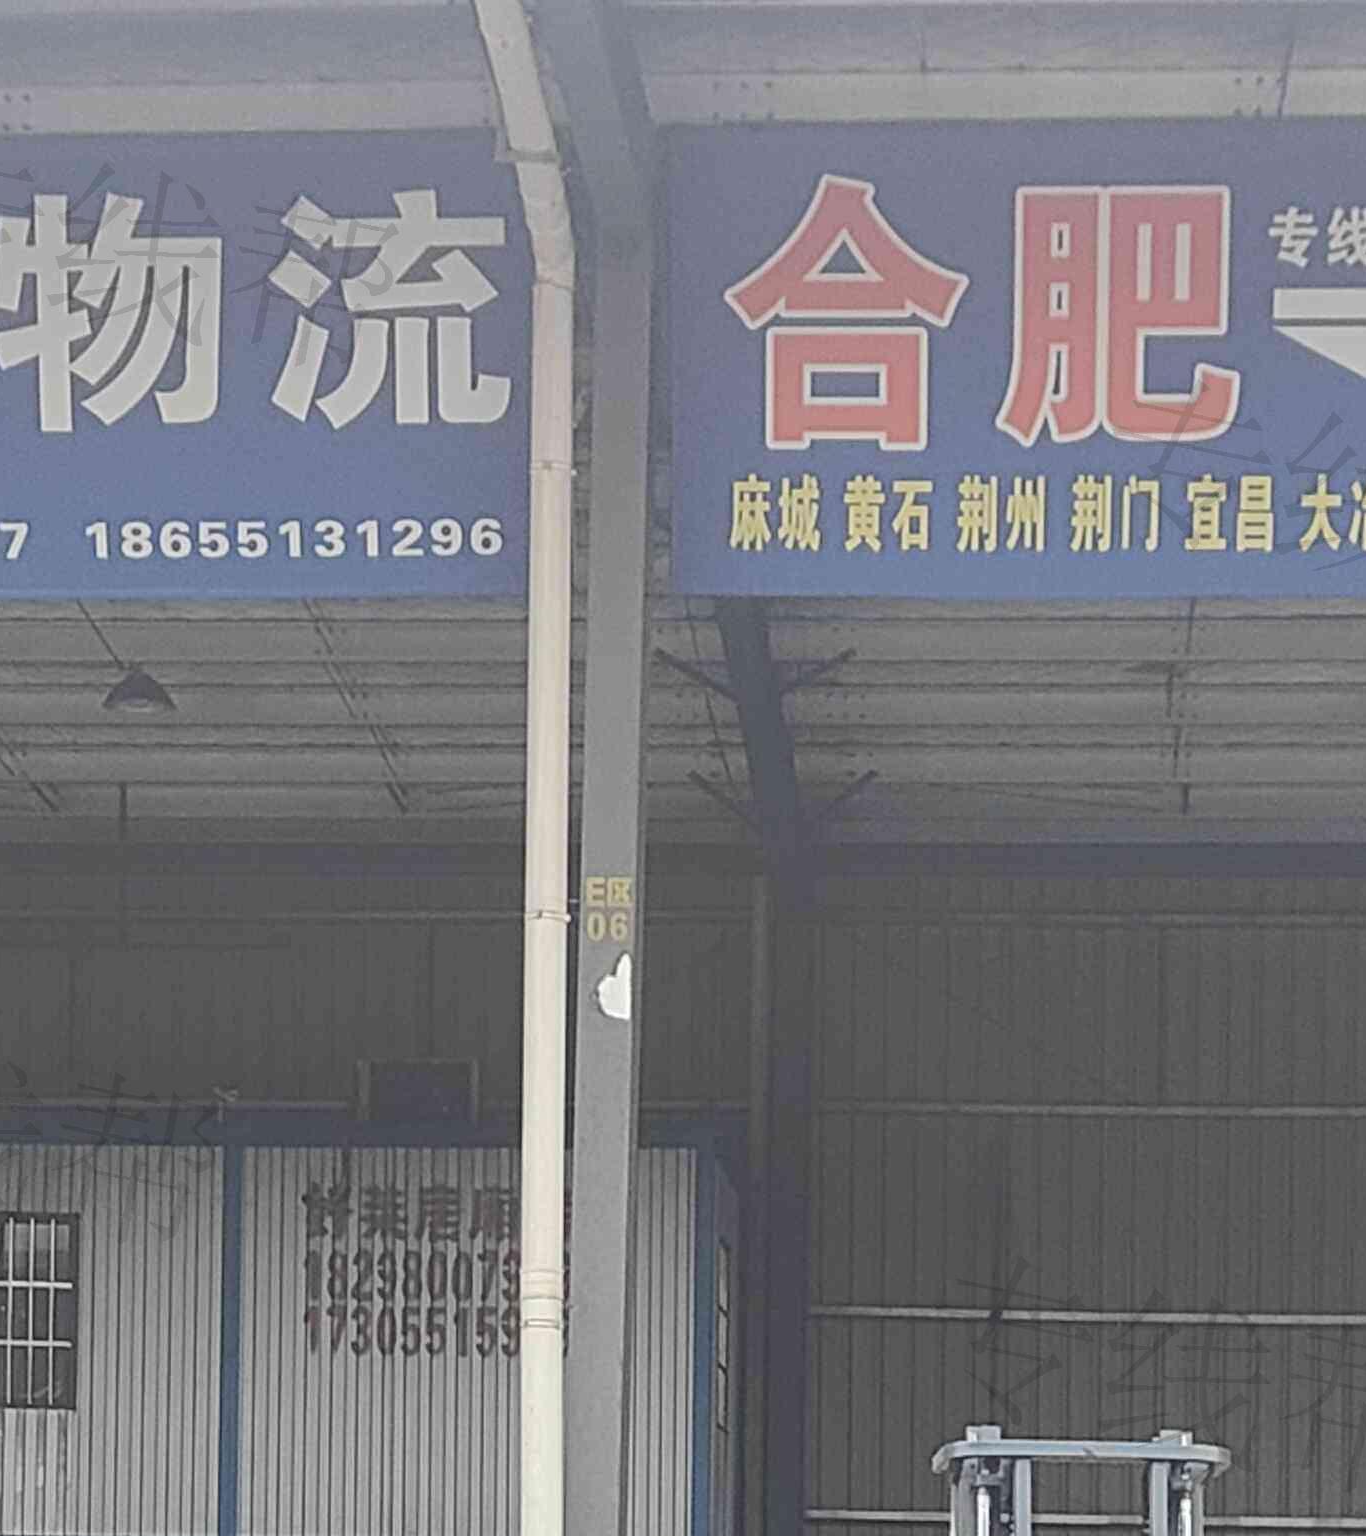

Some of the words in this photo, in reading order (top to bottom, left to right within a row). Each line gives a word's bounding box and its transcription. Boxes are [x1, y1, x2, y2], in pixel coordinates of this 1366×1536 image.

[724, 174, 1241, 450] 合肥
[84, 519, 505, 559] 18655131296
[728, 474, 822, 552] 麻城
[844, 474, 935, 552] 黄石
[956, 474, 1046, 553] 荆州
[1069, 474, 1160, 553] 荆门
[1184, 474, 1275, 553] 宜昌
[586, 911, 628, 942] 06
